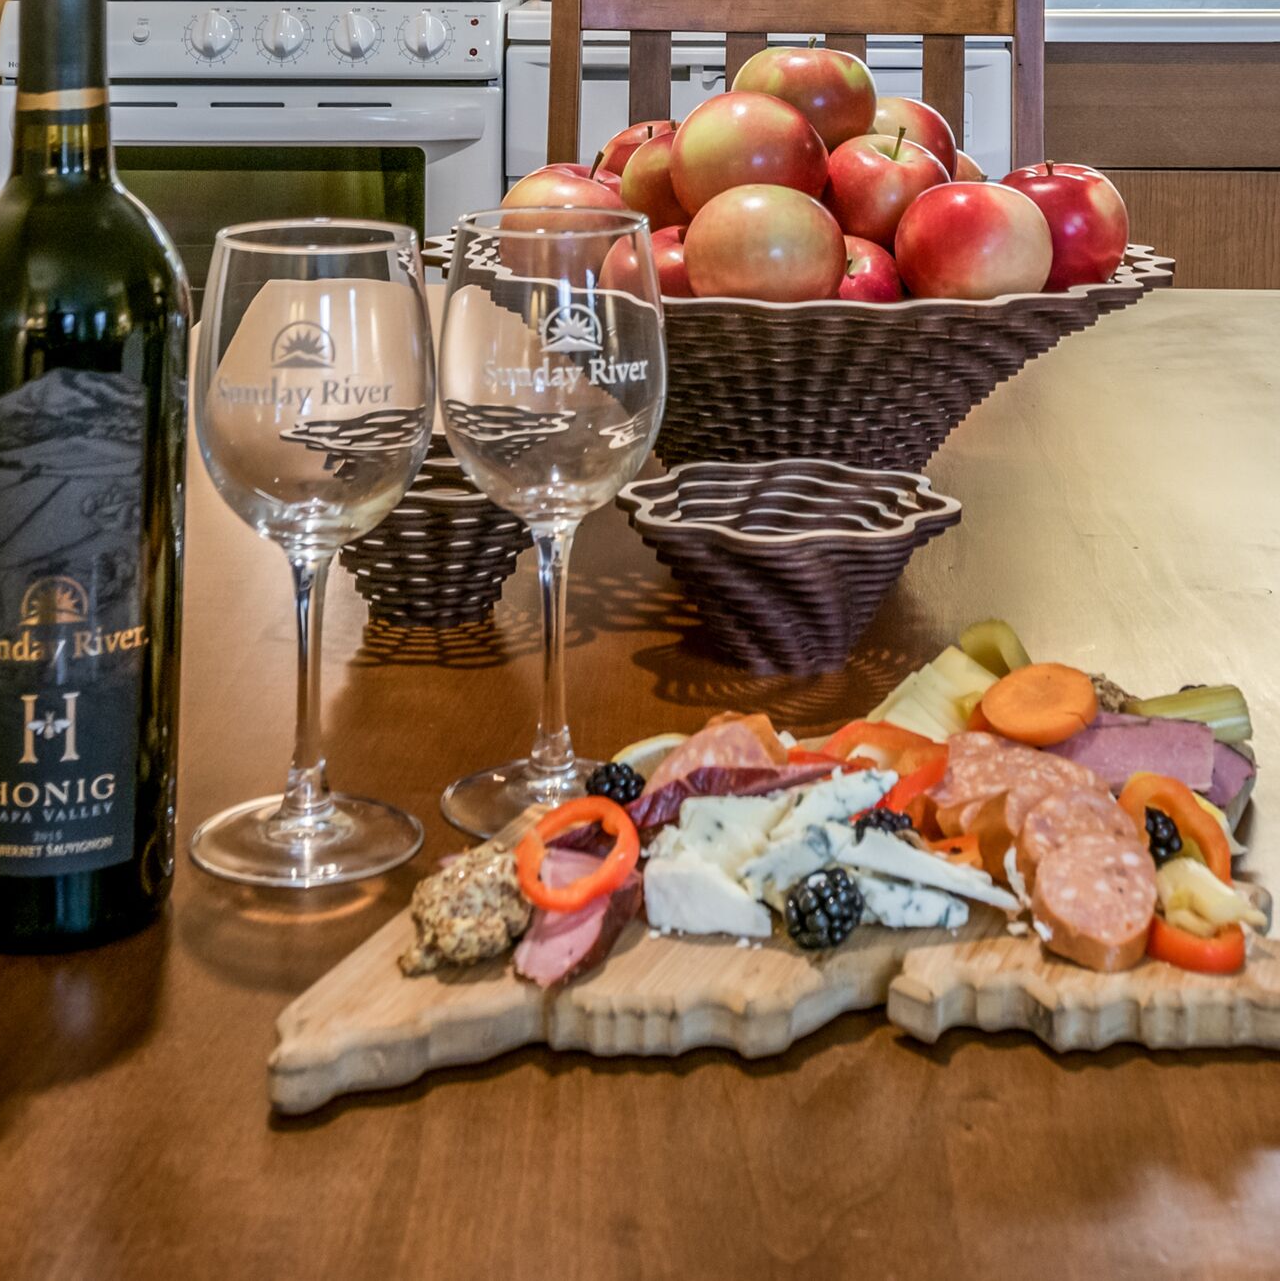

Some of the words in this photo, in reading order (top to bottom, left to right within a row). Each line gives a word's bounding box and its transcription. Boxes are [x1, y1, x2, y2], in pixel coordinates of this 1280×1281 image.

[484, 355, 584, 394] Sunday
[588, 355, 649, 386] River
[216, 376, 313, 415] Sunday
[321, 377, 394, 405] River
[42, 801, 114, 823] VALLEY
